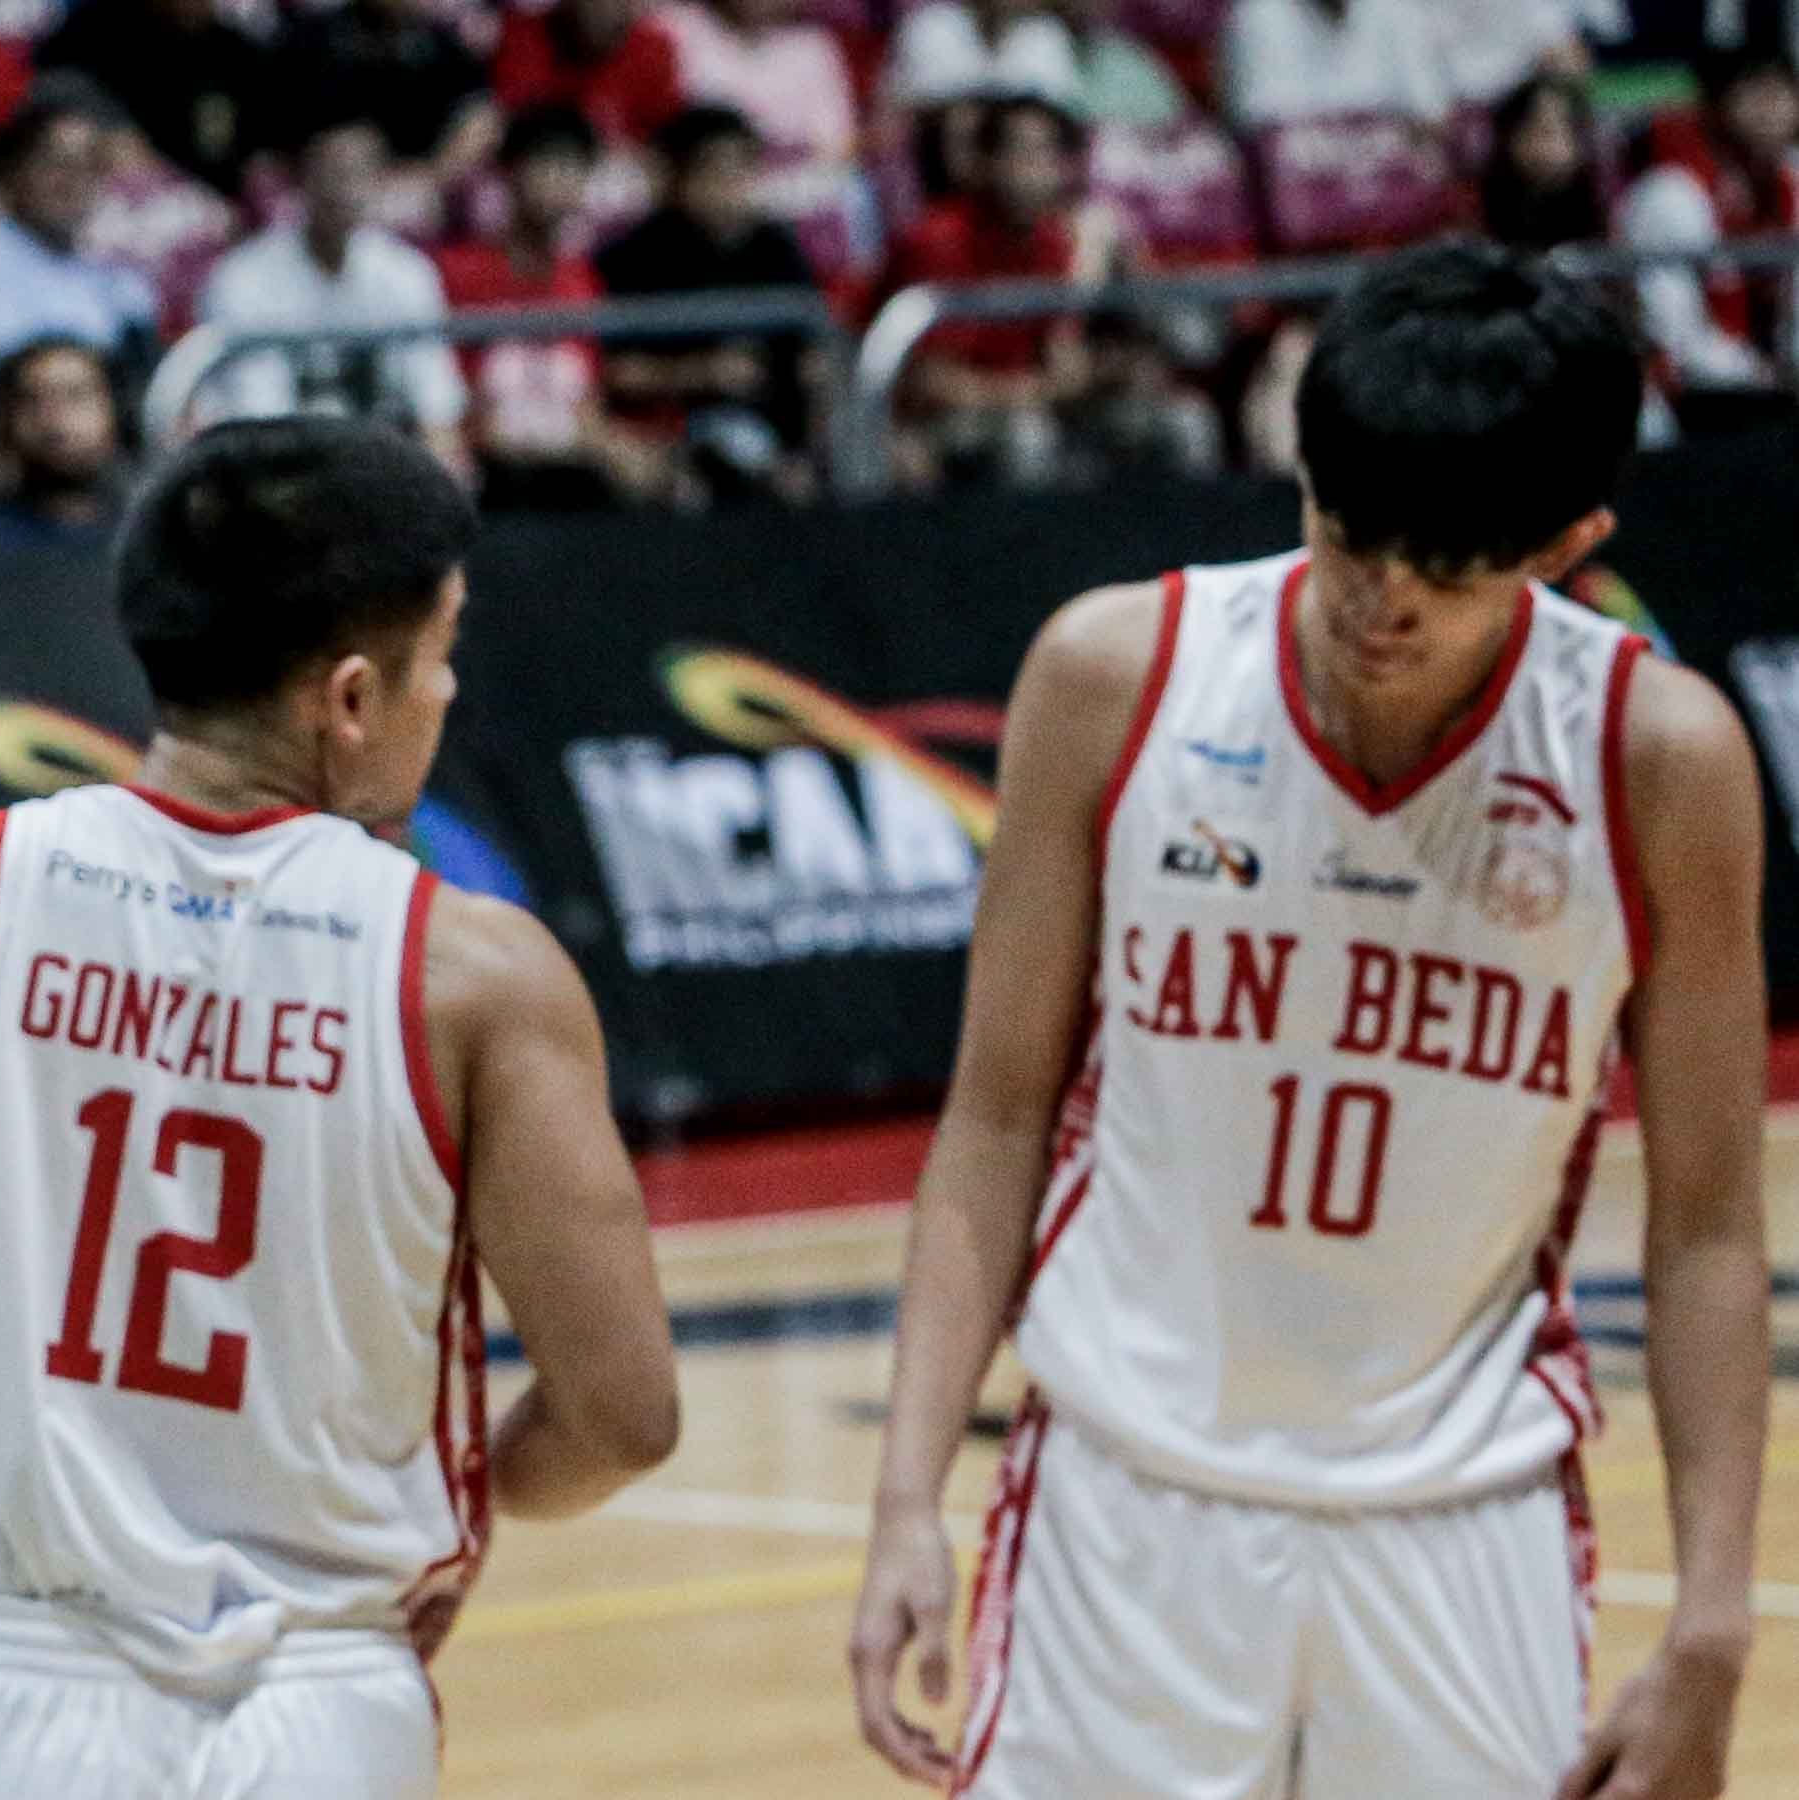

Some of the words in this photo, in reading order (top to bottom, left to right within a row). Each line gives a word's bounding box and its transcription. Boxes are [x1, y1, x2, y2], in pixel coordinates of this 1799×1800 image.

[20, 951, 350, 1096] GONZALES
[1123, 926, 1298, 1044] SAN
[1333, 941, 1573, 1099] BEDA
[1249, 1071, 1393, 1239] 10
[45, 1086, 266, 1415] 12
